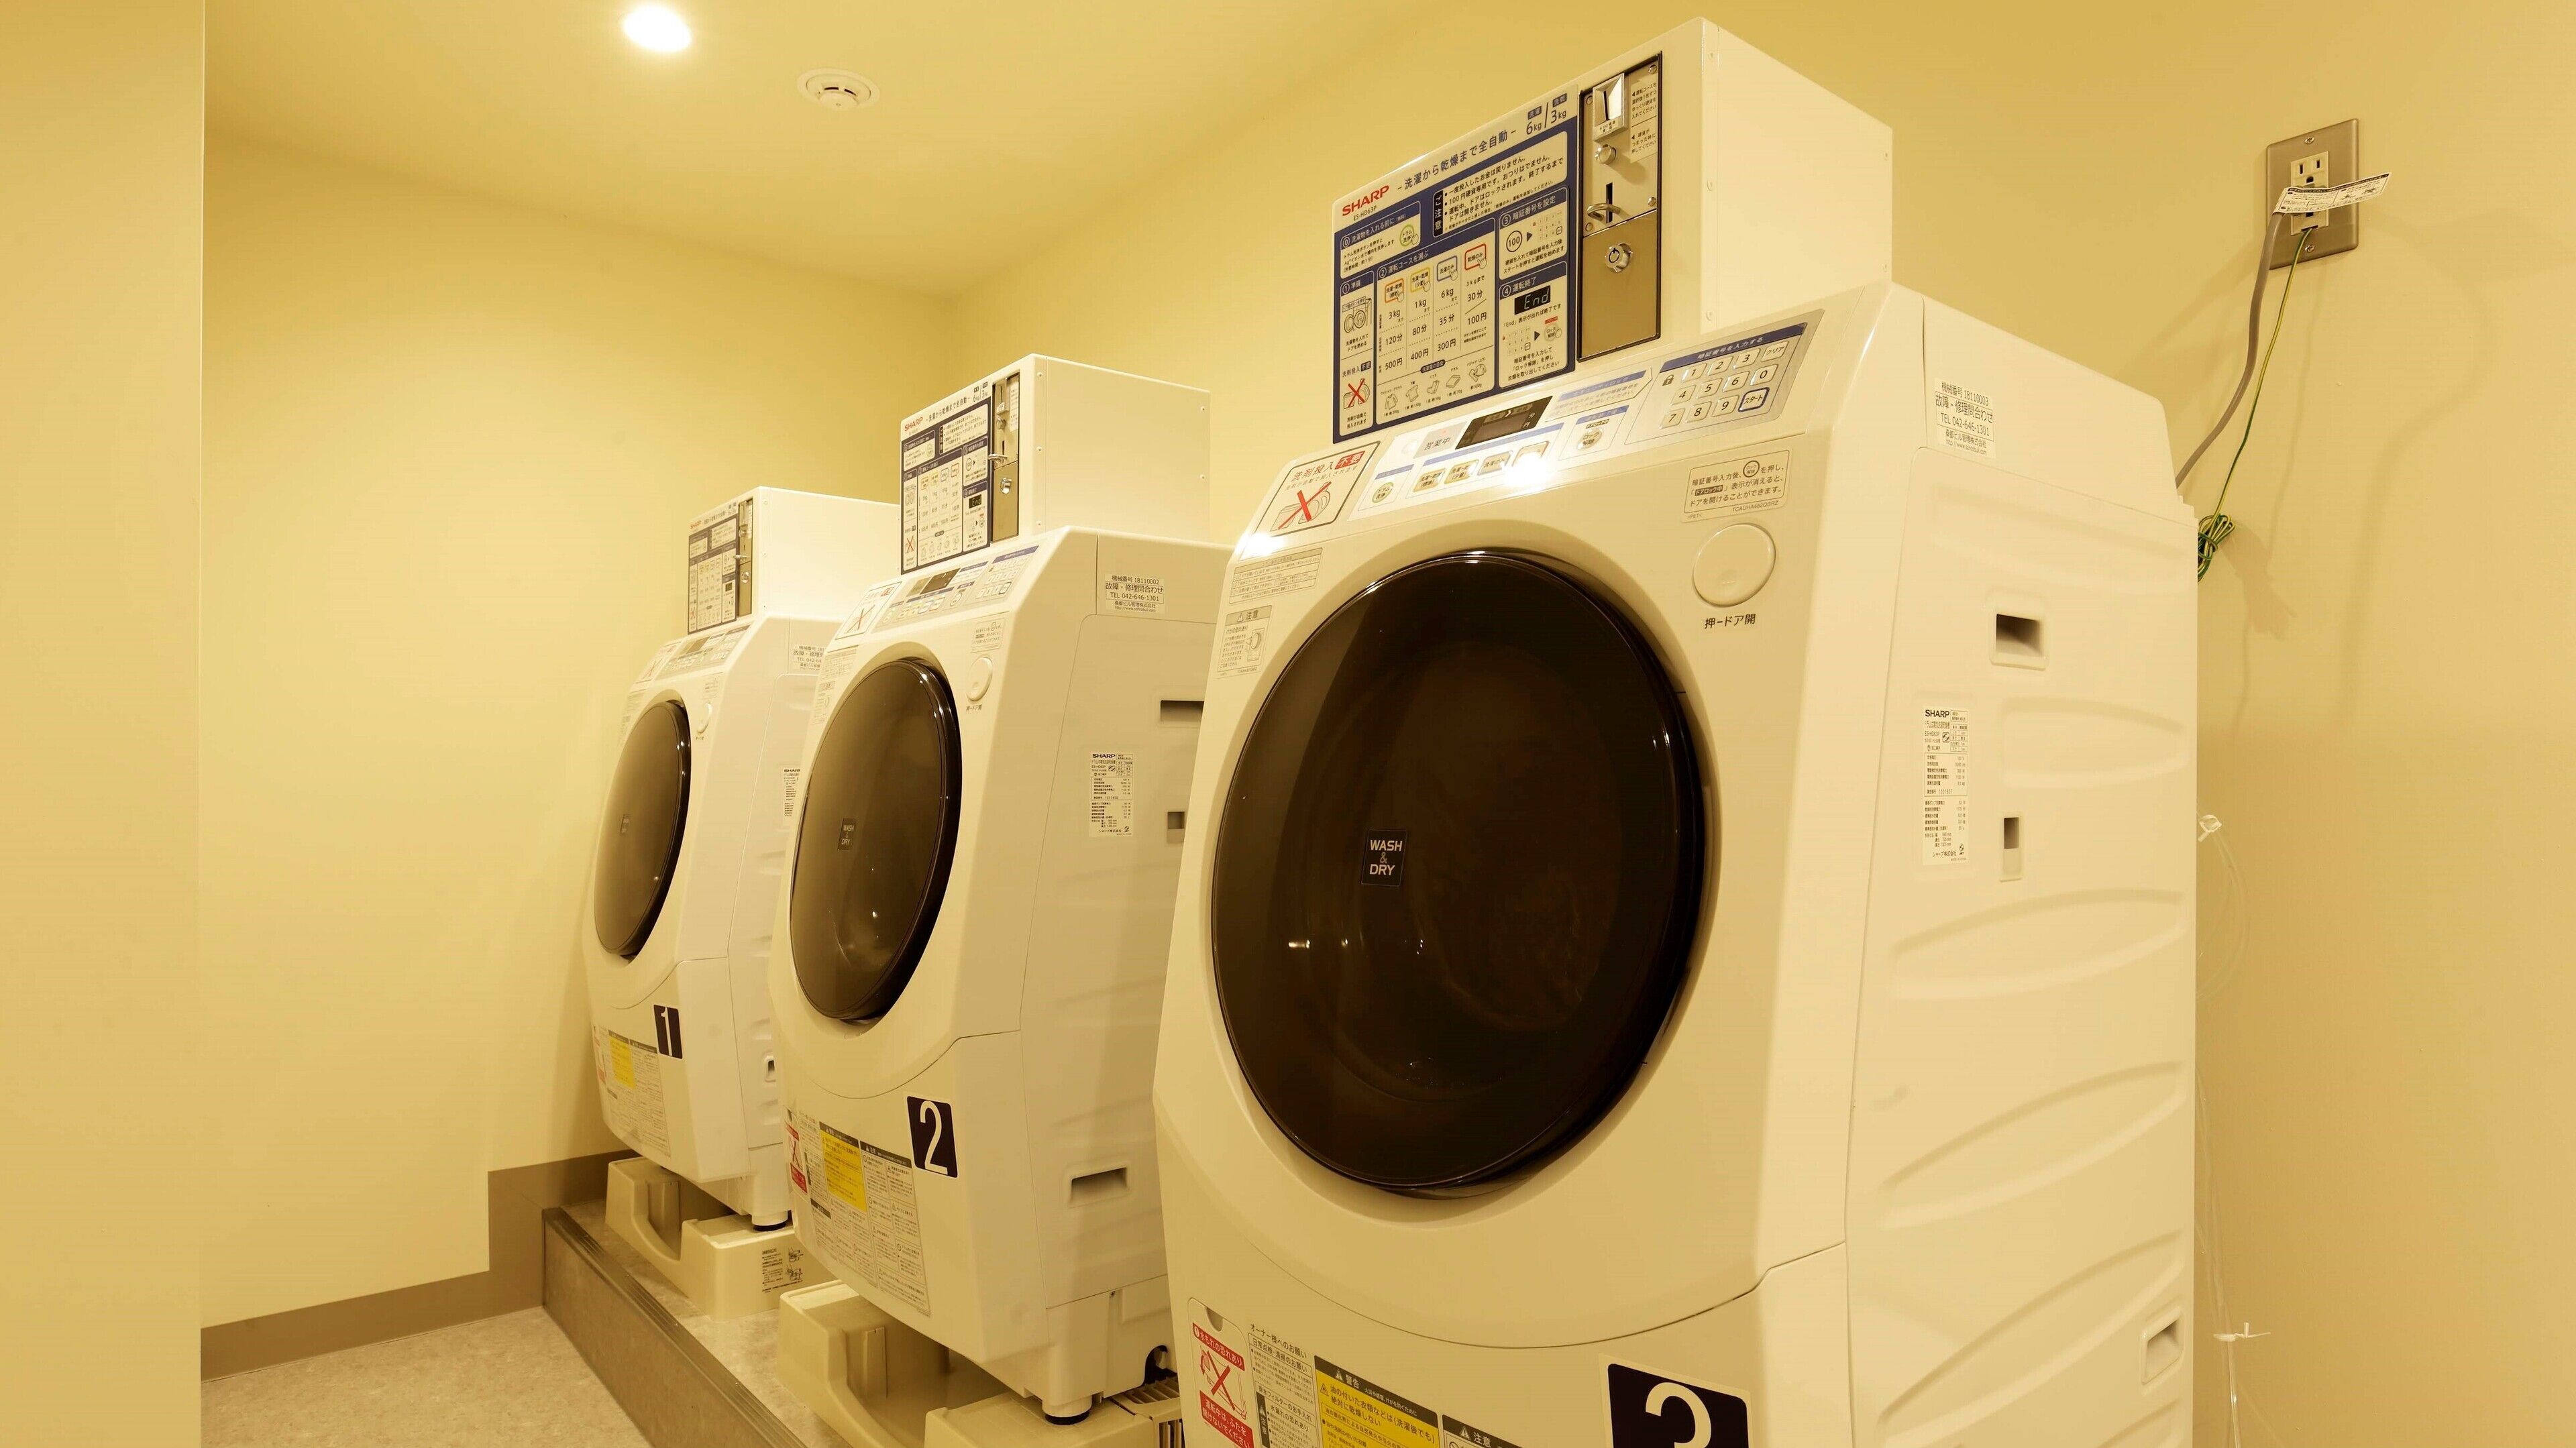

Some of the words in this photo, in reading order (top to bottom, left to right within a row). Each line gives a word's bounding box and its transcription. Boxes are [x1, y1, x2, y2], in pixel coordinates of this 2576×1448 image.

[1526, 121, 1542, 135] 6kg
[1551, 110, 1566, 123] 3kg
[1342, 184, 1389, 216] SHARP
[1508, 236, 1520, 247] 100
[1468, 290, 1483, 302] 30分
[1524, 288, 1550, 310] End
[1439, 313, 1454, 326] 35分
[1468, 312, 1487, 325] 100円
[1413, 324, 1427, 335] 80分
[1386, 333, 1403, 345] 120分
[1438, 338, 1456, 351] 300円
[1411, 348, 1429, 360] 400円
[1385, 357, 1403, 370] 500円
[1715, 361, 1724, 370] 2
[1742, 354, 1750, 363] 3
[1678, 390, 1686, 399] 4
[1704, 384, 1713, 392] 5
[1731, 376, 1739, 386] 6
[1760, 370, 1768, 379] 0
[1669, 413, 1676, 423] 7
[1694, 407, 1702, 416] 8
[1722, 401, 1729, 410] 9
[904, 416, 923, 431] SHARP
[1941, 412, 1951, 425] TEL
[1953, 416, 1989, 437] 042-646-1301
[1690, 486, 1782, 507] ドアを開けることができます。
[1122, 593, 1159, 602] 042-646-1301
[1245, 610, 1258, 621] 注意
[1925, 710, 1950, 718] SHARP
[1370, 839, 1403, 852] WASH
[1380, 851, 1388, 864] &
[1369, 864, 1395, 876] DRY
[661, 1007, 673, 1056] 1
[920, 1101, 949, 1175] 2
[1250, 1323, 1307, 1359] オーナー様へのお願い
[1345, 1374, 1360, 1389] 警告
[1331, 1396, 1381, 1427] 絶対に乾燥しない
[1474, 1432, 1491, 1448] 注意
